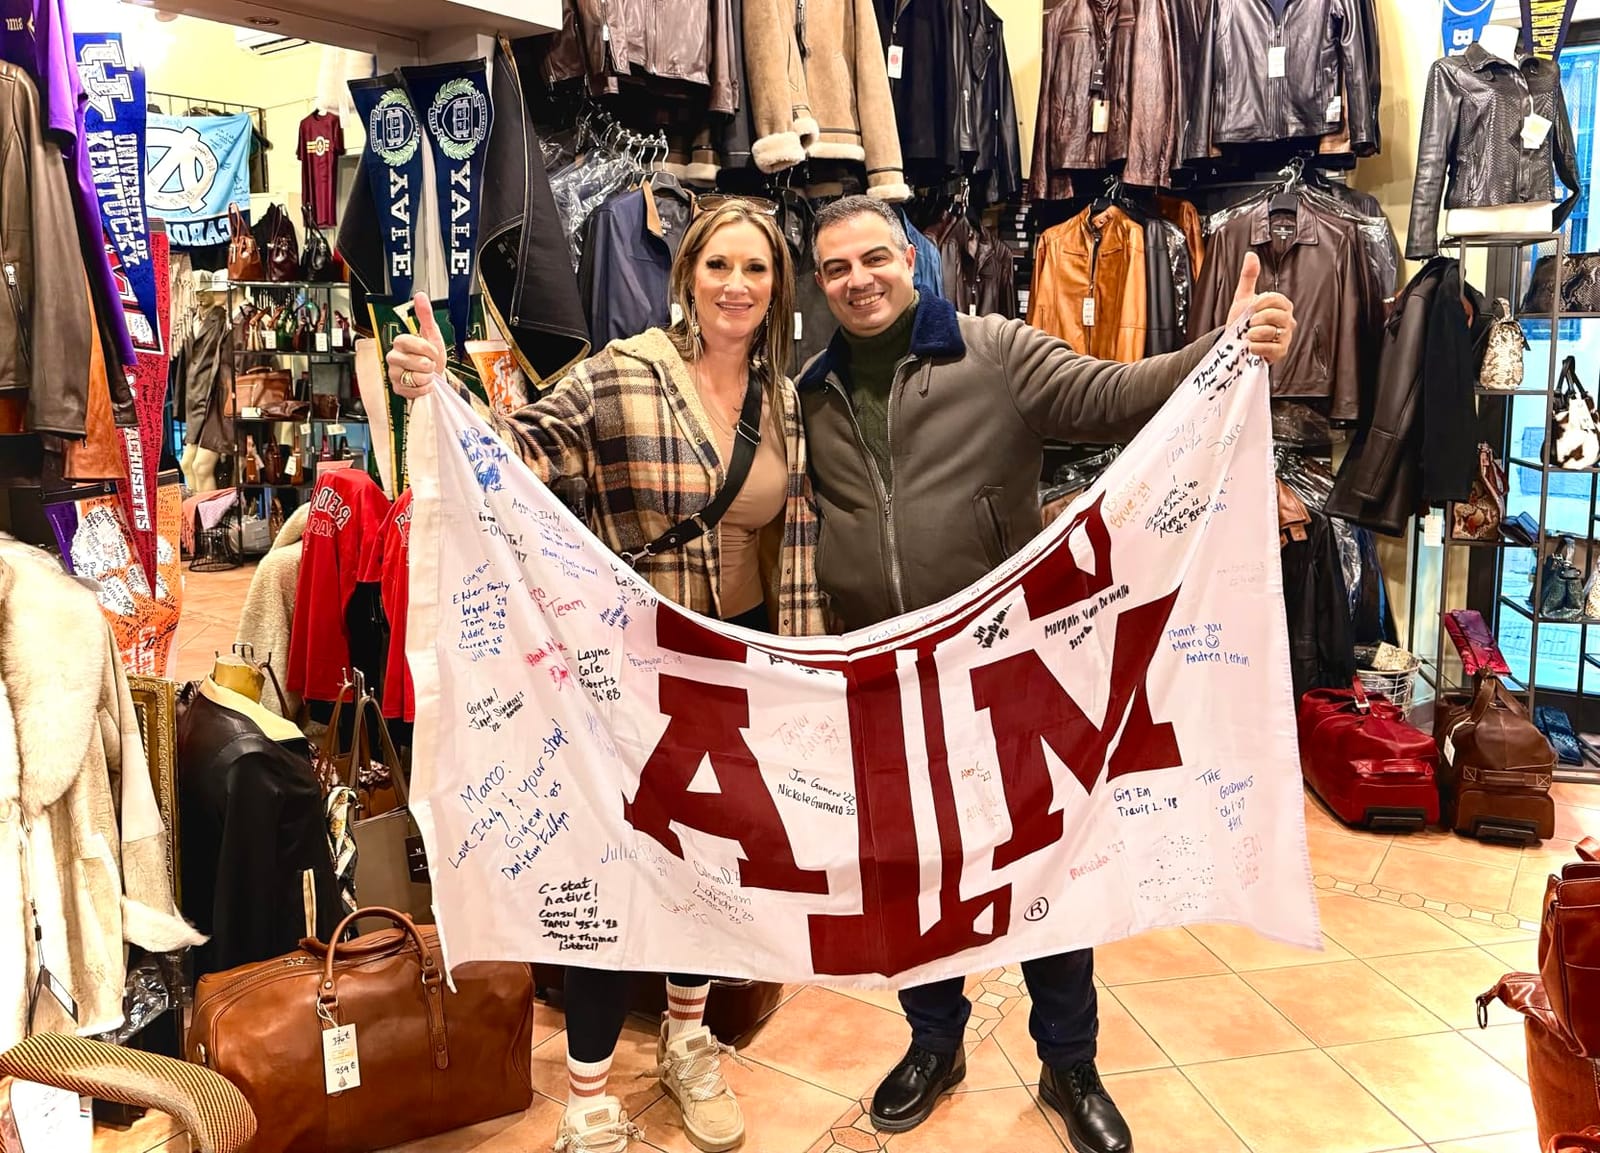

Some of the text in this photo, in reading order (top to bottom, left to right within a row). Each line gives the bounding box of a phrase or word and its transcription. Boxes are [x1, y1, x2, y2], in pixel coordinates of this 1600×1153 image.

[114, 133, 149, 260] UNIVERSITY OF
[450, 161, 472, 276] YALE
[487, 581, 510, 592] Family
[462, 601, 490, 618] Wyatt
[546, 597, 587, 618] Team
[461, 618, 484, 627] Tom
[1044, 613, 1080, 639] Morgan
[1082, 604, 1099, 620] Van
[460, 628, 485, 642] Addie
[1167, 623, 1222, 640] Thank you
[1172, 638, 1203, 651] Marco
[577, 648, 611, 663] Layne
[1186, 651, 1221, 664] Andrea
[578, 663, 604, 677] Cole
[1195, 768, 1221, 786] THE
[842, 791, 856, 806] '22
[1113, 788, 1131, 802] Gig
[448, 839, 479, 869] Love
[471, 807, 511, 841] Italy
[518, 756, 545, 798] your
[845, 805, 856, 816] '22
[1118, 805, 1149, 817] Travis
[524, 845, 543, 863] Kim
[600, 843, 637, 864] Julia
[538, 876, 593, 894] C-stat
[545, 882, 598, 906] native!
[538, 905, 598, 918] Consol '91
[541, 919, 570, 928] TAMU
[577, 932, 618, 942] Thomas
